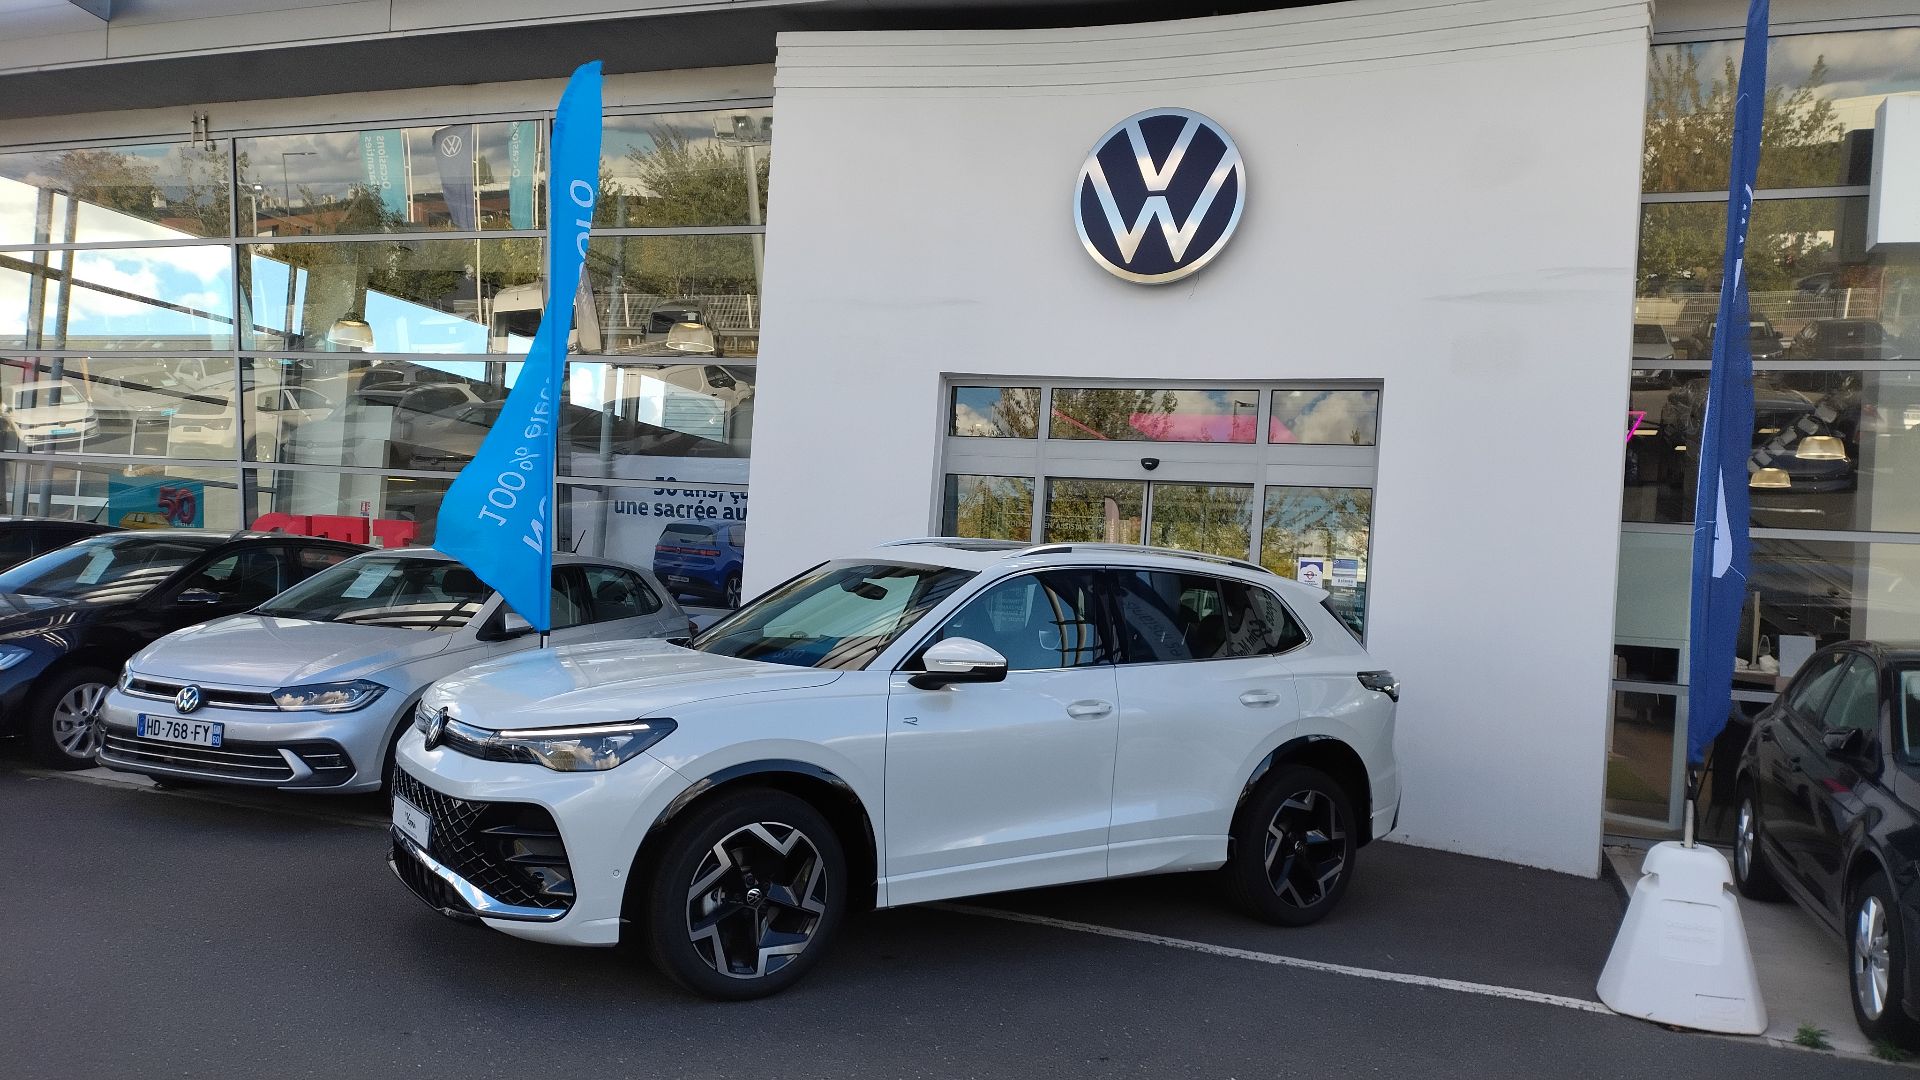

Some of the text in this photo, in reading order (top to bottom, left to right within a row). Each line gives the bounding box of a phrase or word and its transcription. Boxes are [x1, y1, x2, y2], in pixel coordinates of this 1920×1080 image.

[1074, 107, 1247, 285] VW
[158, 485, 196, 524] 50
[614, 500, 649, 516] une
[653, 500, 718, 520] sacrée
